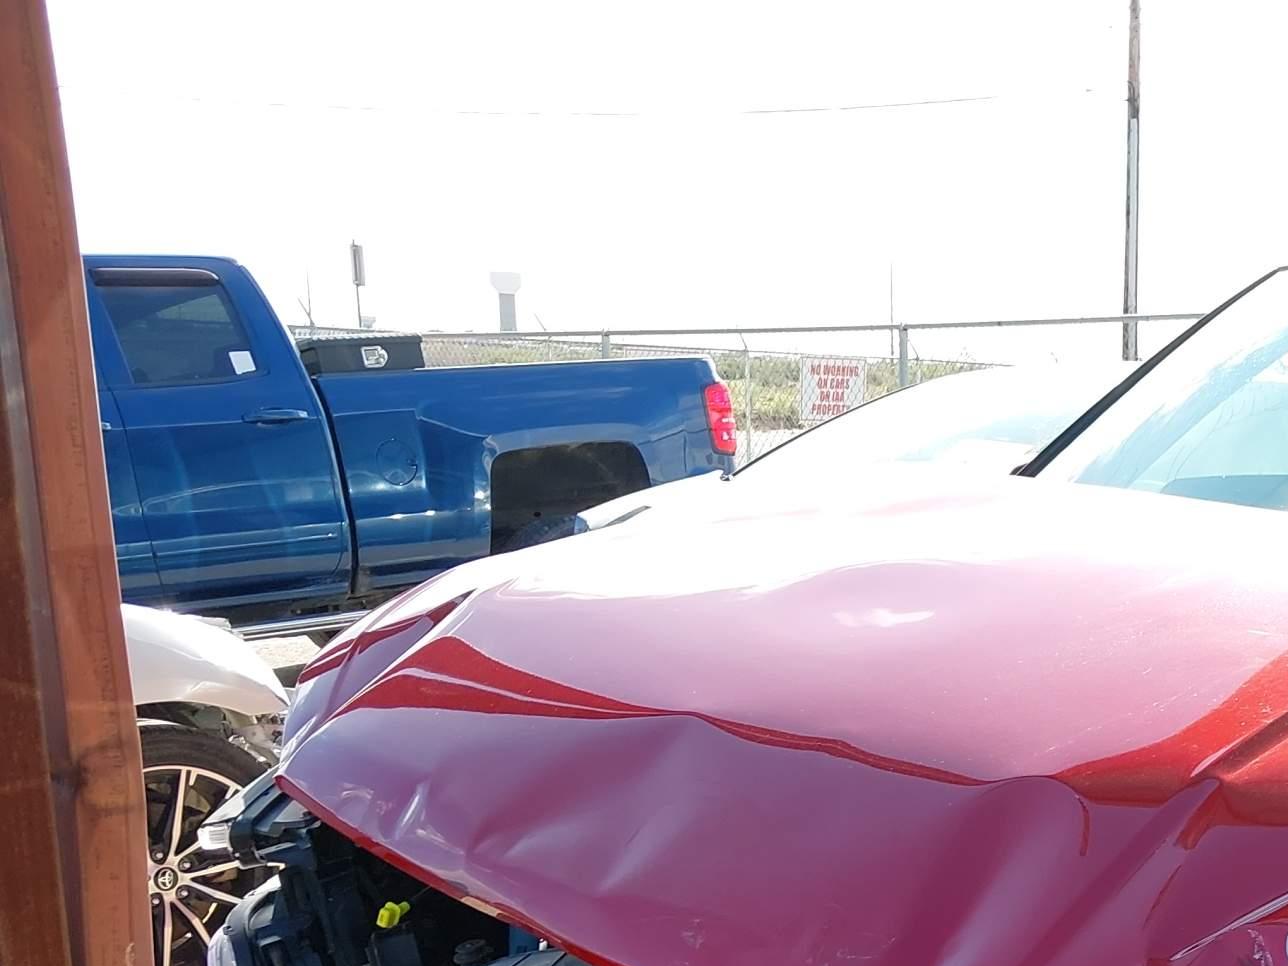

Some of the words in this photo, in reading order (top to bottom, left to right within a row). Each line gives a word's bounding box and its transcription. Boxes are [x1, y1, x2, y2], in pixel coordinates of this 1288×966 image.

[811, 365, 820, 375] NO
[824, 365, 859, 376] WORKING
[818, 378, 827, 389] ON
[830, 379, 849, 389] CARS
